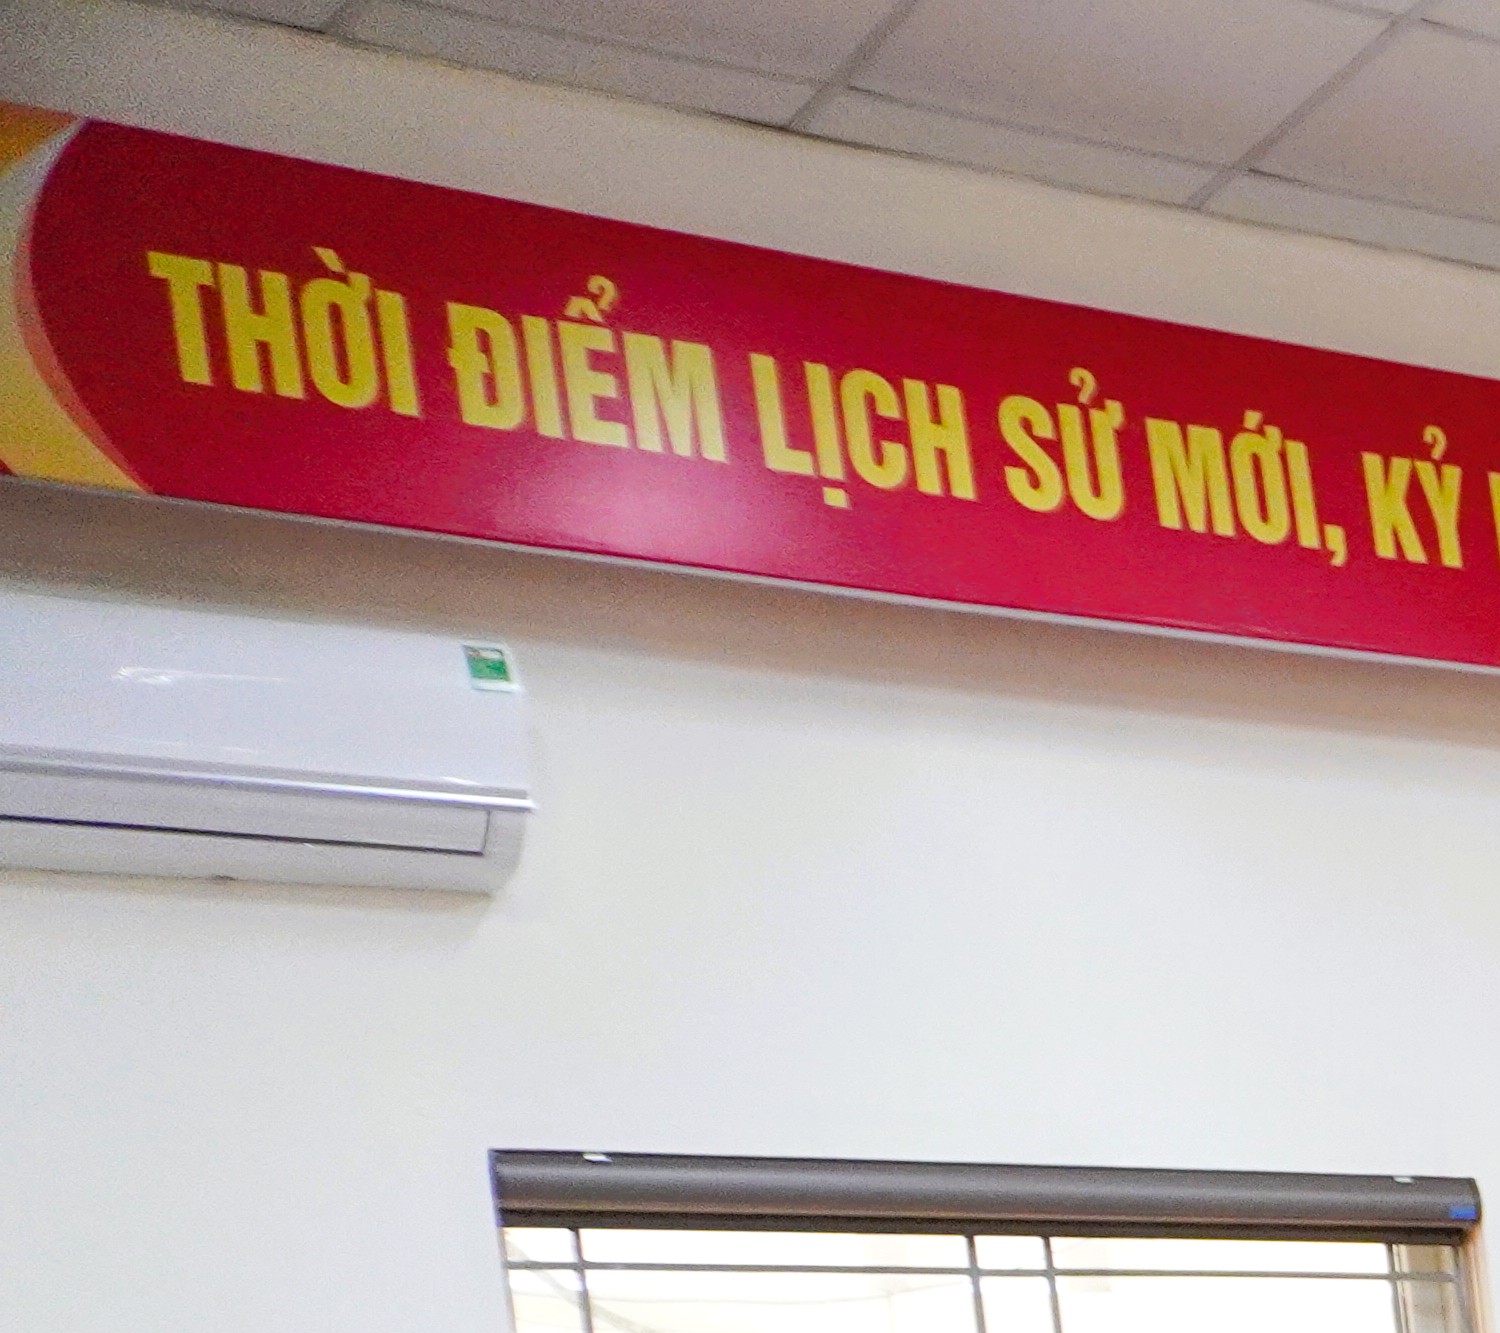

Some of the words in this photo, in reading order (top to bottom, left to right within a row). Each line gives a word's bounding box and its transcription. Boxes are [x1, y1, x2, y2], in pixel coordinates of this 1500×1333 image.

[148, 246, 418, 416] THỜI
[447, 275, 728, 463] ĐIỂM
[751, 353, 976, 509] LỊCH
[999, 368, 1124, 520] SỬ
[1146, 410, 1347, 565] MỚI,
[1363, 426, 1463, 568] KỶ
